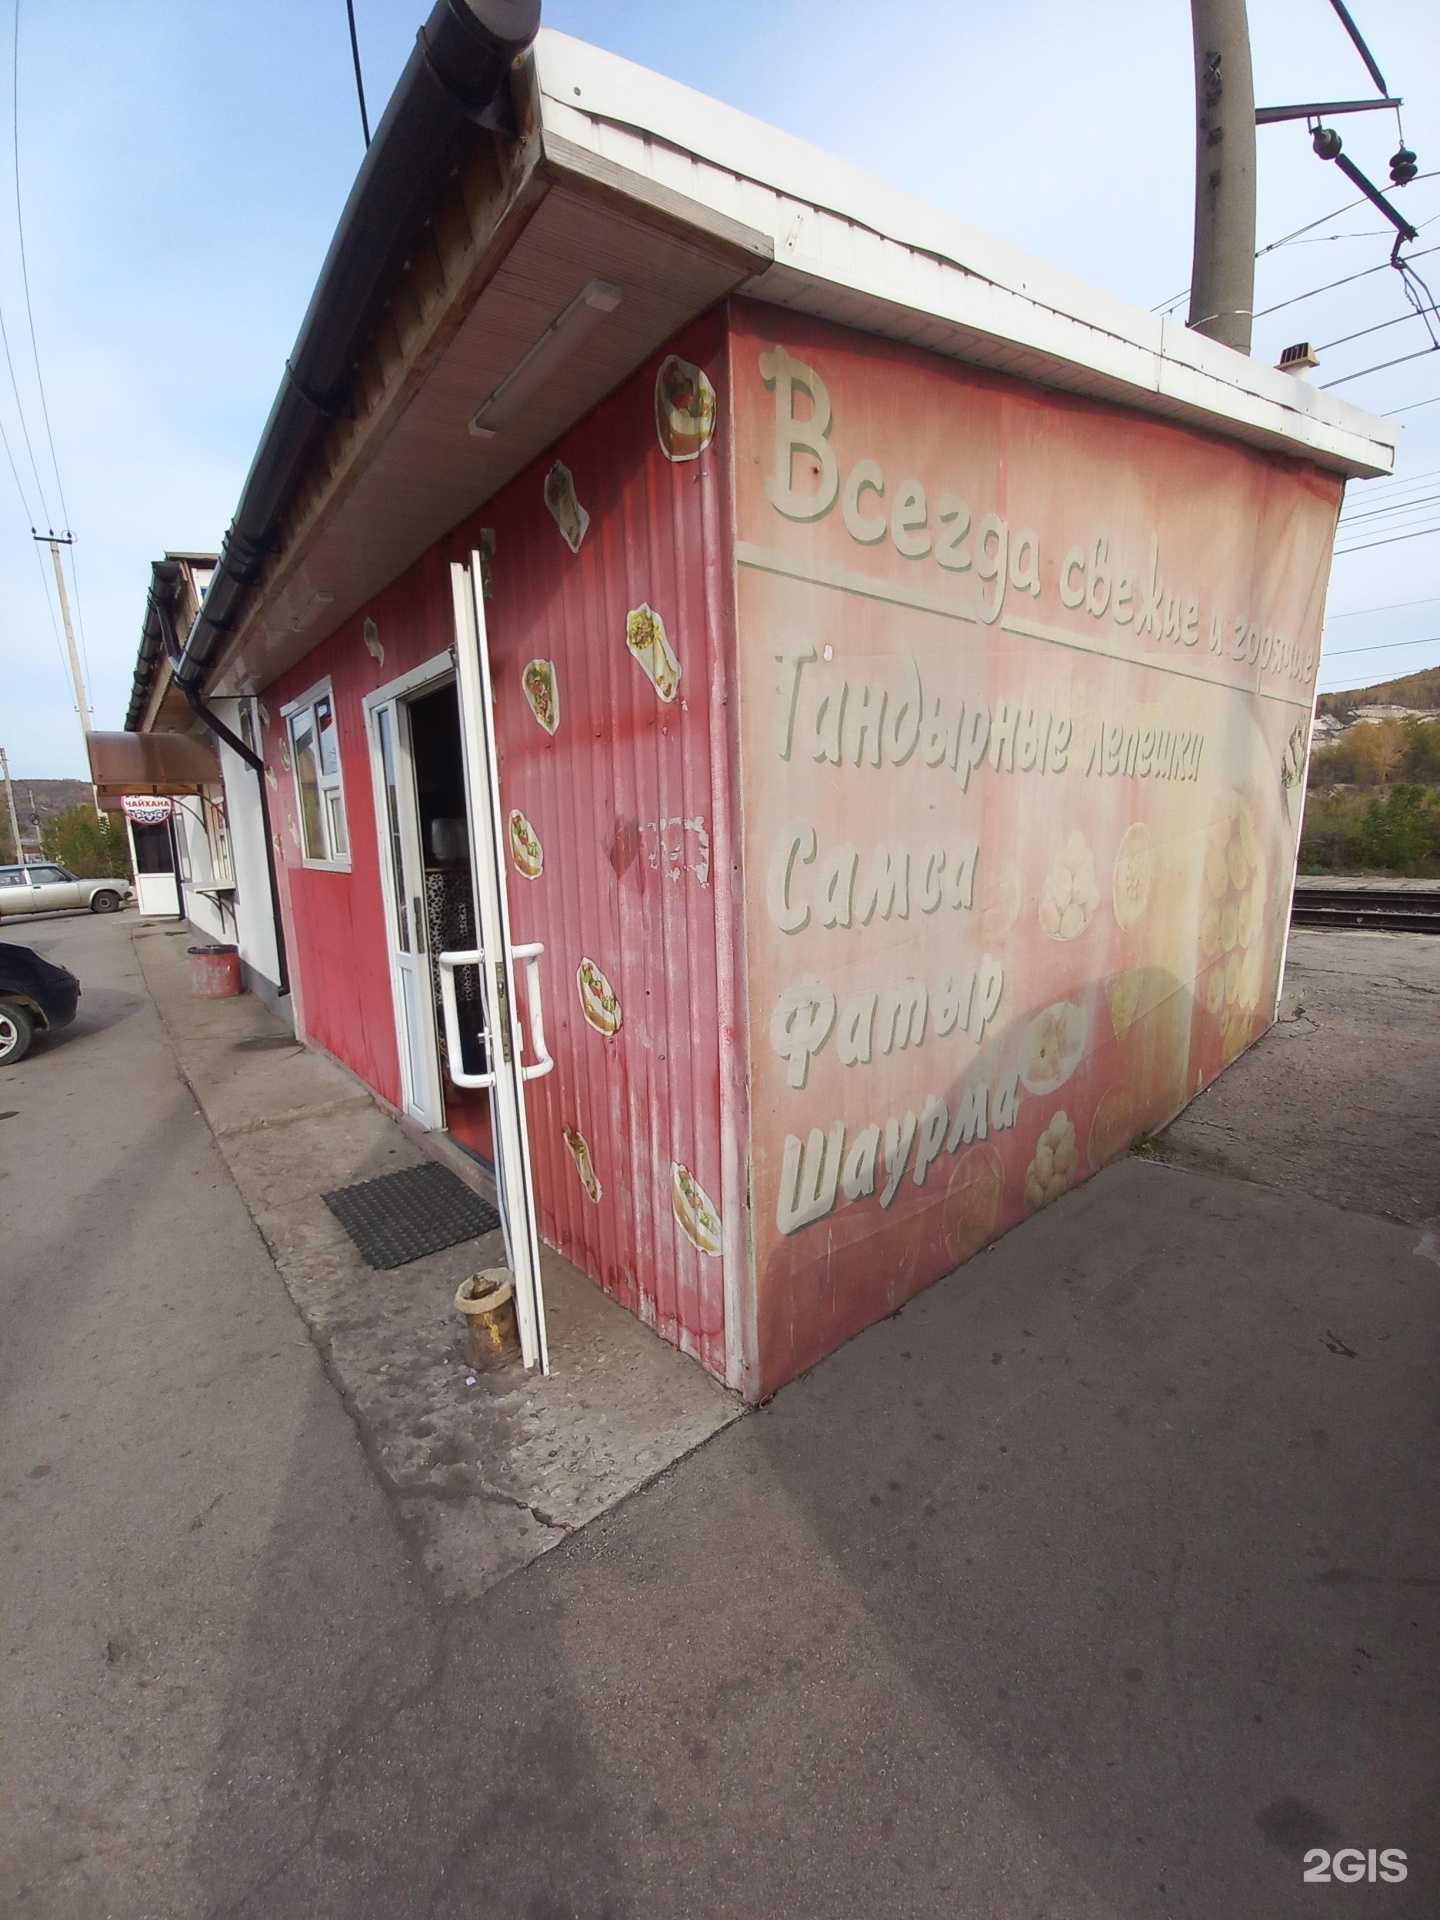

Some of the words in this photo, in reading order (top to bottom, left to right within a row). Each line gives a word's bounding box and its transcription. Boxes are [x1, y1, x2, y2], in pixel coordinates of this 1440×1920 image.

[758, 344, 1041, 625] Всегда
[1059, 527, 1200, 647] свежие
[1208, 611, 1224, 656] и
[770, 640, 1073, 794] Тандырные
[1085, 719, 1205, 782] лепешки
[768, 821, 979, 935] Самса
[770, 953, 1005, 1089] Фатыр
[776, 1072, 1021, 1236] Шаурма
